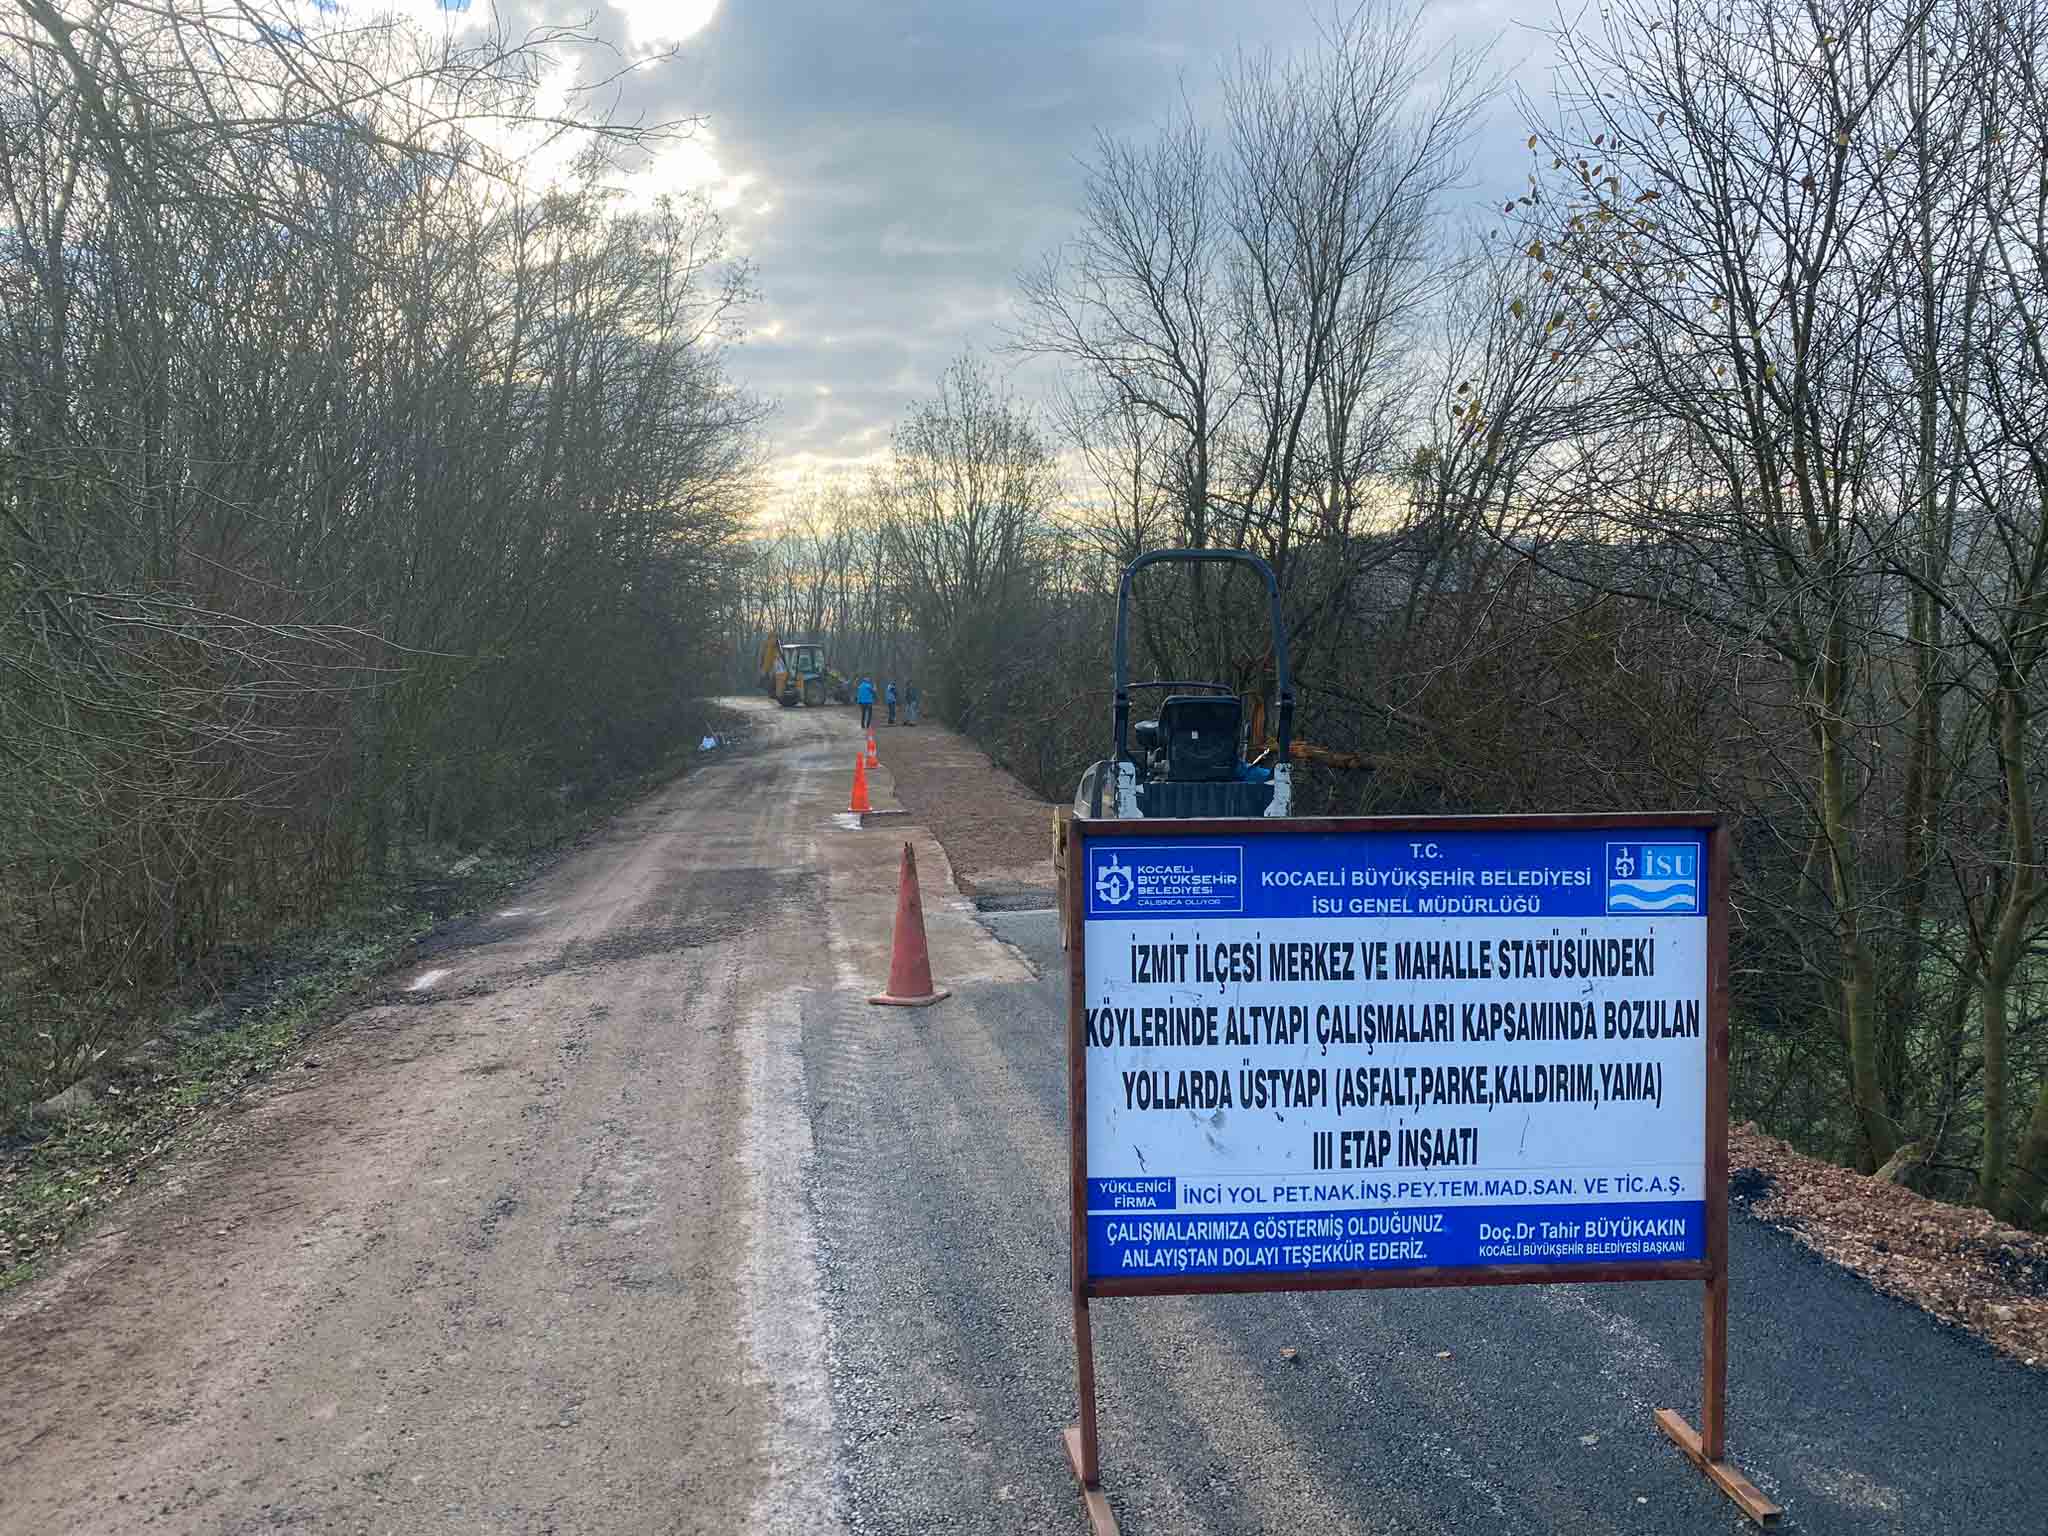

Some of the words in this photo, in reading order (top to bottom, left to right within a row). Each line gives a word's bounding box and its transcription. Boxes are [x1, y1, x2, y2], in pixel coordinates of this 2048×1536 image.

[1409, 842, 1443, 858] T.C.
[1646, 850, 1692, 876] İSU
[1261, 868, 1345, 886] KOCAELİ
[1351, 868, 1475, 889] BÜYÜKŞEHİR
[1481, 867, 1591, 886] BELEDİYESİ
[1312, 895, 1342, 913] İSU
[1349, 898, 1413, 913] GENEL
[1418, 895, 1540, 913] MÜDÜRLÜĞÜ
[1131, 932, 1188, 983] İZMİT
[1195, 931, 1262, 994] İLÇESİ
[1269, 942, 1355, 981] MERKEZ
[1361, 941, 1388, 980] VE
[1394, 940, 1491, 980] MAHALLE
[1498, 927, 1655, 979] STATÜSÜNDEKİ
[1085, 995, 1218, 1048] KÖYLERİNDE
[1225, 1005, 1309, 1045] ALTYAPI
[1316, 1003, 1454, 1056] ÇALIŞMALARI
[1462, 1001, 1598, 1042] KAPSAMINDA
[1604, 999, 1700, 1040] BOZULAN
[1122, 1069, 1233, 1111] YOLLARDA
[1239, 1058, 1327, 1109] ÜSTYAPI
[1313, 1131, 1333, 1170] III
[1341, 1130, 1391, 1169] ETAP
[1398, 1118, 1478, 1170] İNŞAATI
[1099, 1180, 1171, 1193] YÜKLENİCİ
[1184, 1184, 1222, 1204] İNCİ
[1228, 1187, 1267, 1203] YOL
[1584, 1178, 1609, 1193] VE
[1614, 1173, 1686, 1196] TİC.A.Ş.
[1114, 1195, 1156, 1208] FİRMA
[1107, 1221, 1250, 1246] ÇALIŞMALARIMIZA
[1253, 1214, 1343, 1240] GÖSTERMİŞ
[1348, 1210, 1443, 1236] OLDUĞUNUZ
[1479, 1222, 1536, 1243] Doç.Dr
[1540, 1220, 1581, 1240] Tahir
[1584, 1217, 1686, 1238] BÜYÜKAKIN
[1122, 1248, 1218, 1271] ANLAYIŞTAN
[1223, 1247, 1279, 1266] DOLAYI
[1283, 1240, 1364, 1268] TEŞEKKÜR
[1369, 1237, 1427, 1260] EDERİZ.
[1479, 1243, 1522, 1257] KOCAELİ
[1523, 1241, 1584, 1257] BÜYÜKŞEHİR
[1586, 1240, 1641, 1255] BELEDİYESİ
[1643, 1240, 1685, 1255] BAŞKANI
